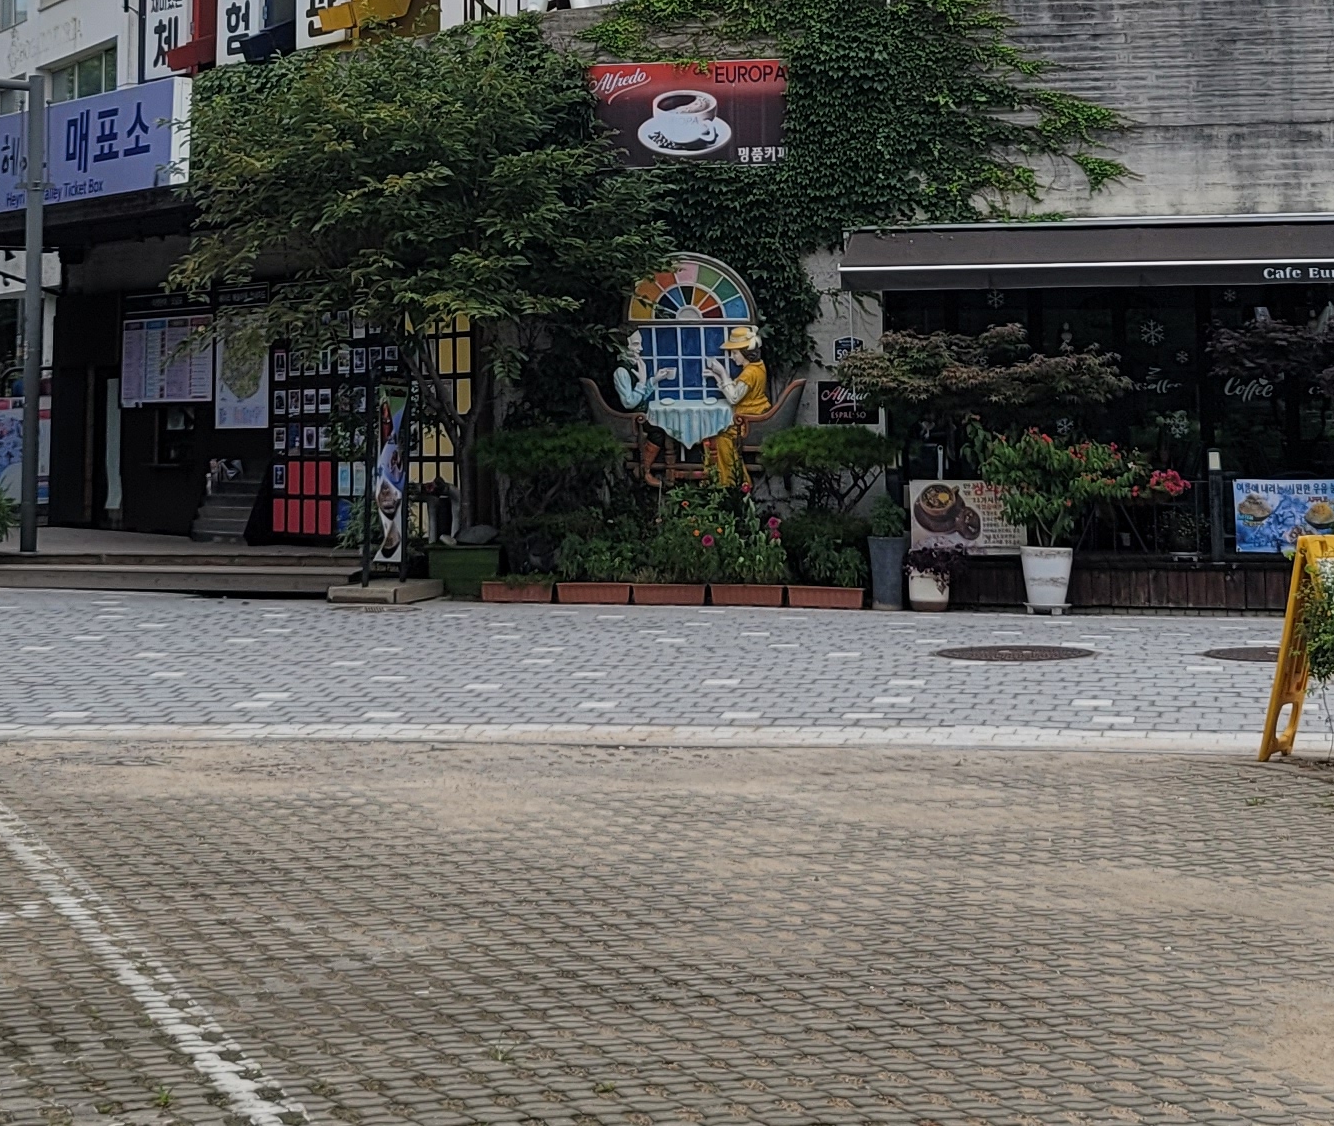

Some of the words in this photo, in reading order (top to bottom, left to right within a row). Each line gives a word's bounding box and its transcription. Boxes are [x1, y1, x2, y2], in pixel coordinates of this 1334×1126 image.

[590, 67, 647, 94] Alfredo
[714, 65, 788, 84] EUROPA
[65, 101, 151, 173] 매표소
[43, 182, 61, 202] alley
[63, 180, 87, 198] Ticket
[88, 178, 104, 194] Box
[1263, 266, 1302, 279] Cafe
[1224, 376, 1274, 402] Coffee
[830, 410, 867, 419] ESPRESO
[1313, 482, 1328, 494] 우유
